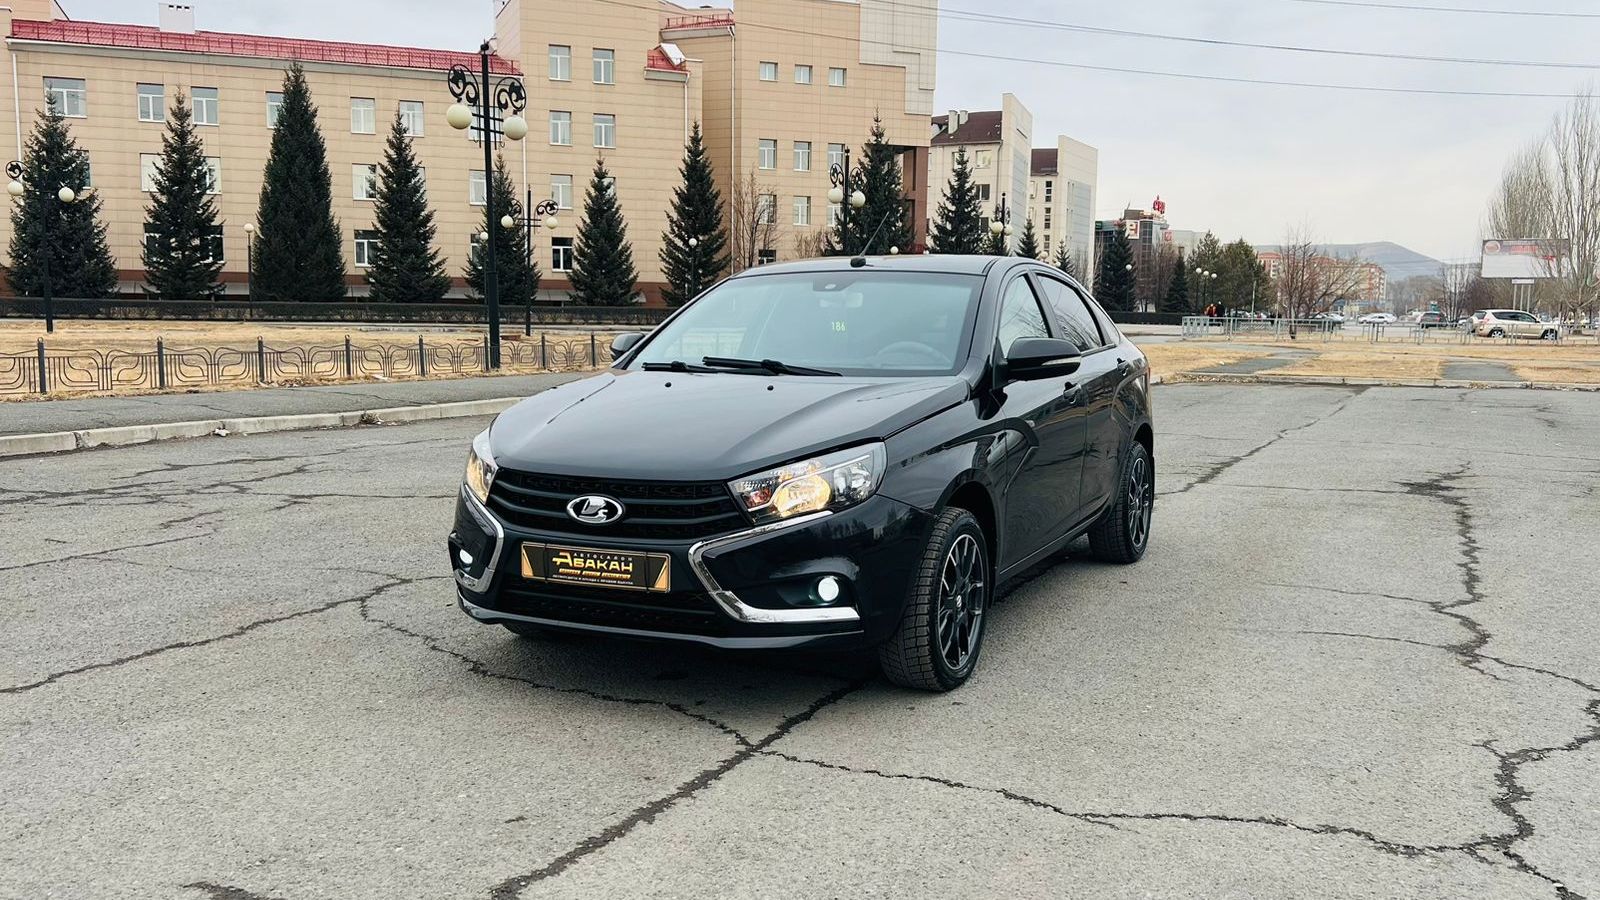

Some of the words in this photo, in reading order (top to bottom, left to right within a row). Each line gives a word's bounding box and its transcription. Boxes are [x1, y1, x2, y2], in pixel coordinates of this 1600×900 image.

[832, 321, 845, 331] 186
[552, 551, 633, 572] АБАКАН
[573, 553, 633, 561] АВТОСАЛОН
